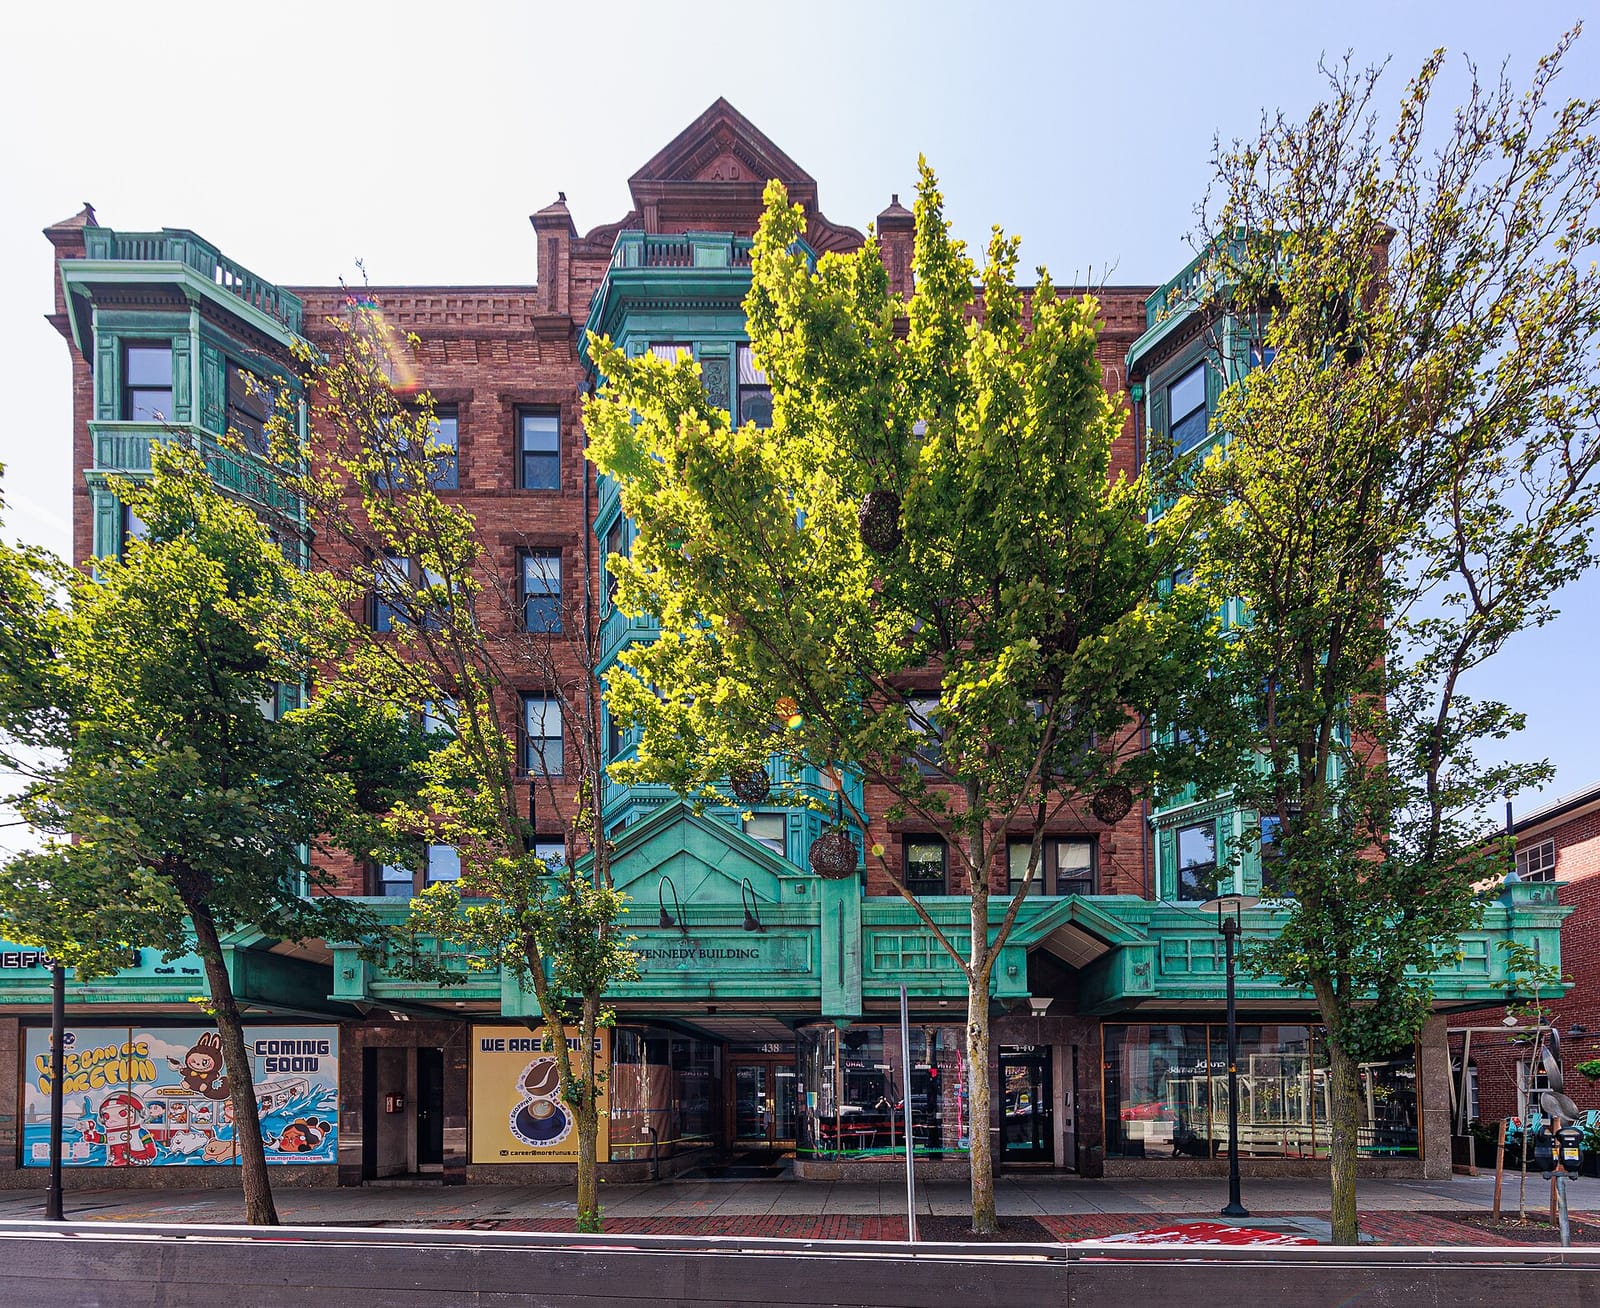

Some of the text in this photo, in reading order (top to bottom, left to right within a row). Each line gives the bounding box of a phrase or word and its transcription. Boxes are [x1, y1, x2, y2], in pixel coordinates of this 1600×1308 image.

[699, 949, 759, 959] BUILDING
[154, 966, 200, 976] Café Toys
[255, 1040, 330, 1055] COMING
[481, 1038, 505, 1052] WE
[508, 1038, 541, 1052] ARE
[761, 1043, 780, 1053] 438
[265, 1057, 319, 1072] SOON
